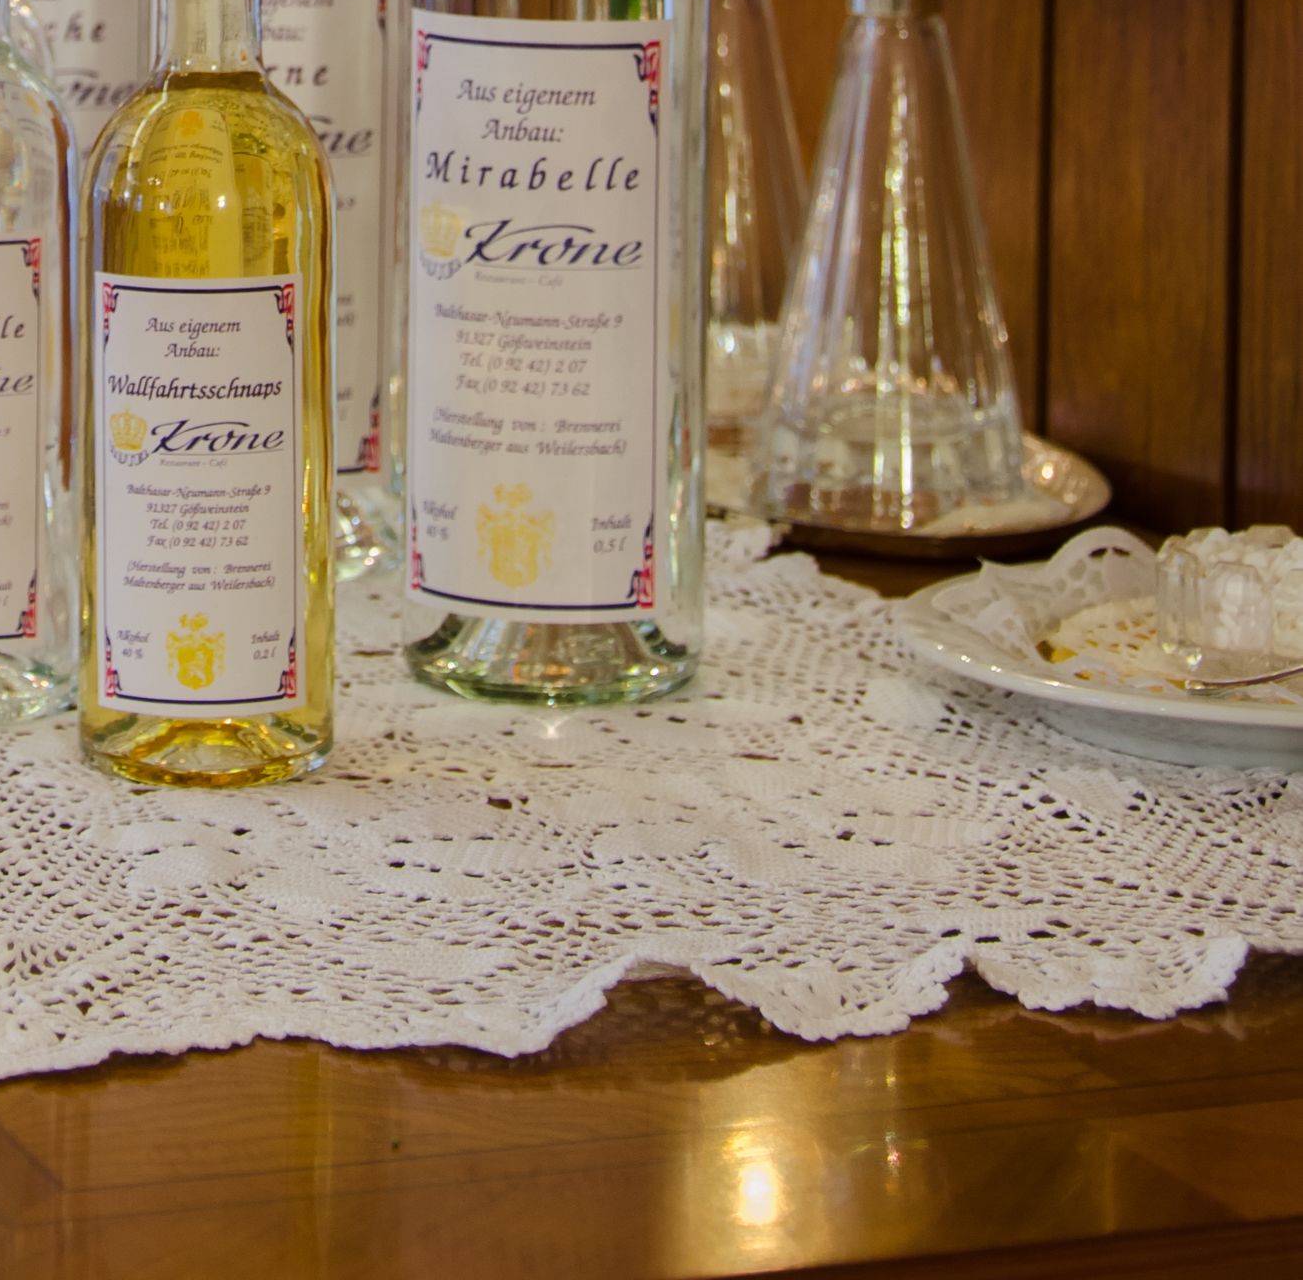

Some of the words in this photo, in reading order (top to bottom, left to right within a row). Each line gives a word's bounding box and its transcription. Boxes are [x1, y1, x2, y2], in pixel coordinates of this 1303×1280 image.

[456, 80, 496, 101] Aus
[503, 84, 596, 114] eigenem
[481, 119, 565, 143] Anbau:
[426, 150, 639, 191] Mirabelle
[464, 217, 642, 265] Krone
[145, 318, 174, 333] Aus
[180, 319, 241, 339] eigenem
[164, 342, 220, 358] Anbau:
[108, 375, 282, 400] Wallfahrtsschnaps
[150, 419, 284, 454] Krone
[146, 536, 168, 548] Fax
